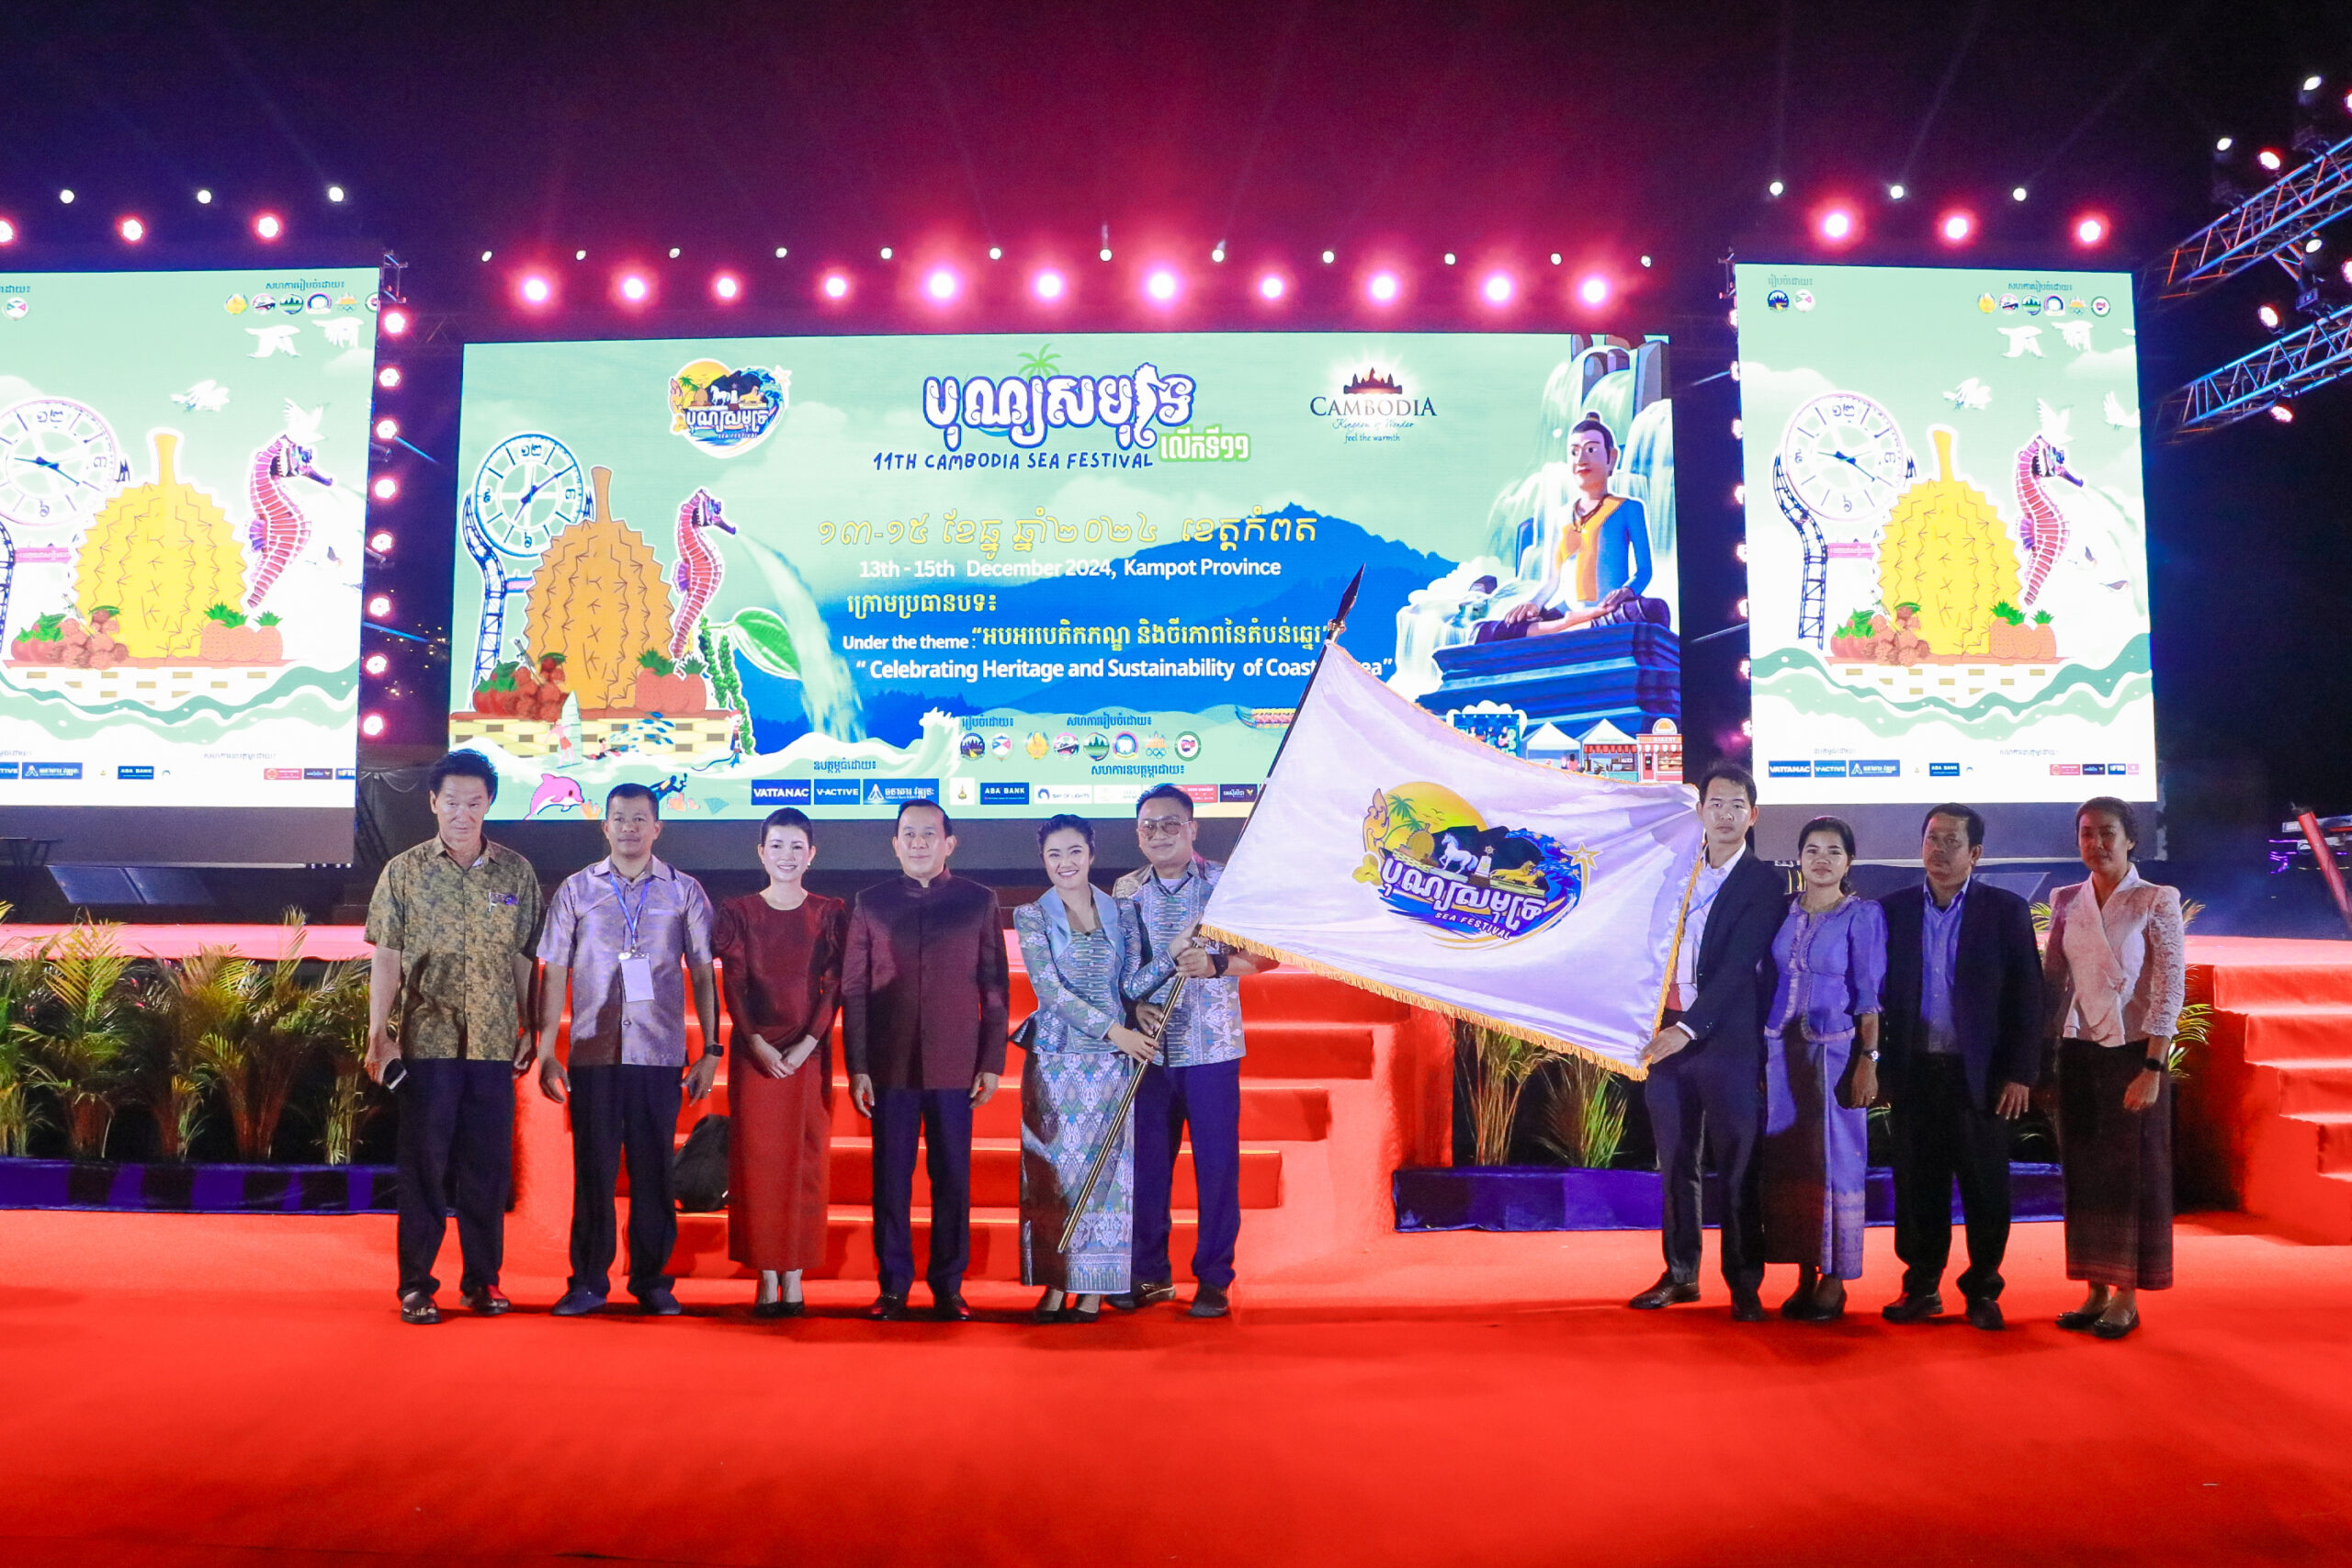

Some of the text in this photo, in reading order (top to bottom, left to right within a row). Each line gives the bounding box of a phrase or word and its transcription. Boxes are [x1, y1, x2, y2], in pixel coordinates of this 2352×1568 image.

[1310, 396, 1437, 416] CAMBODIA
[1160, 426, 1250, 460] លើកទី១១
[874, 451, 1153, 470] 11TH CAMBODIA SEA FESTIVAL
[819, 513, 929, 545] ១៣-១៥
[943, 509, 1003, 560] ខែធ្នូ
[1182, 505, 1317, 552] ខេត្តកំពត
[859, 560, 900, 578] 13th
[914, 559, 956, 578] 15th
[966, 558, 1063, 577] December
[1065, 559, 1117, 580] 2024,
[1124, 558, 1198, 581] Kampot
[1201, 558, 1282, 576] Province
[847, 594, 997, 620] ក្រោមប្រធានបទ៖
[842, 636, 889, 650] Under
[891, 635, 917, 649] the
[870, 660, 978, 682] Celebrating
[982, 660, 1064, 682] Heritage
[1068, 659, 1104, 678] and
[1108, 658, 1235, 681] Sustainability
[1243, 658, 1262, 677] of
[1266, 659, 1317, 677] Coast
[1770, 765, 1811, 773] VATTANAC
[753, 788, 809, 797] VATTANAC
[1435, 911, 1510, 940] SEA FESTIVAL
